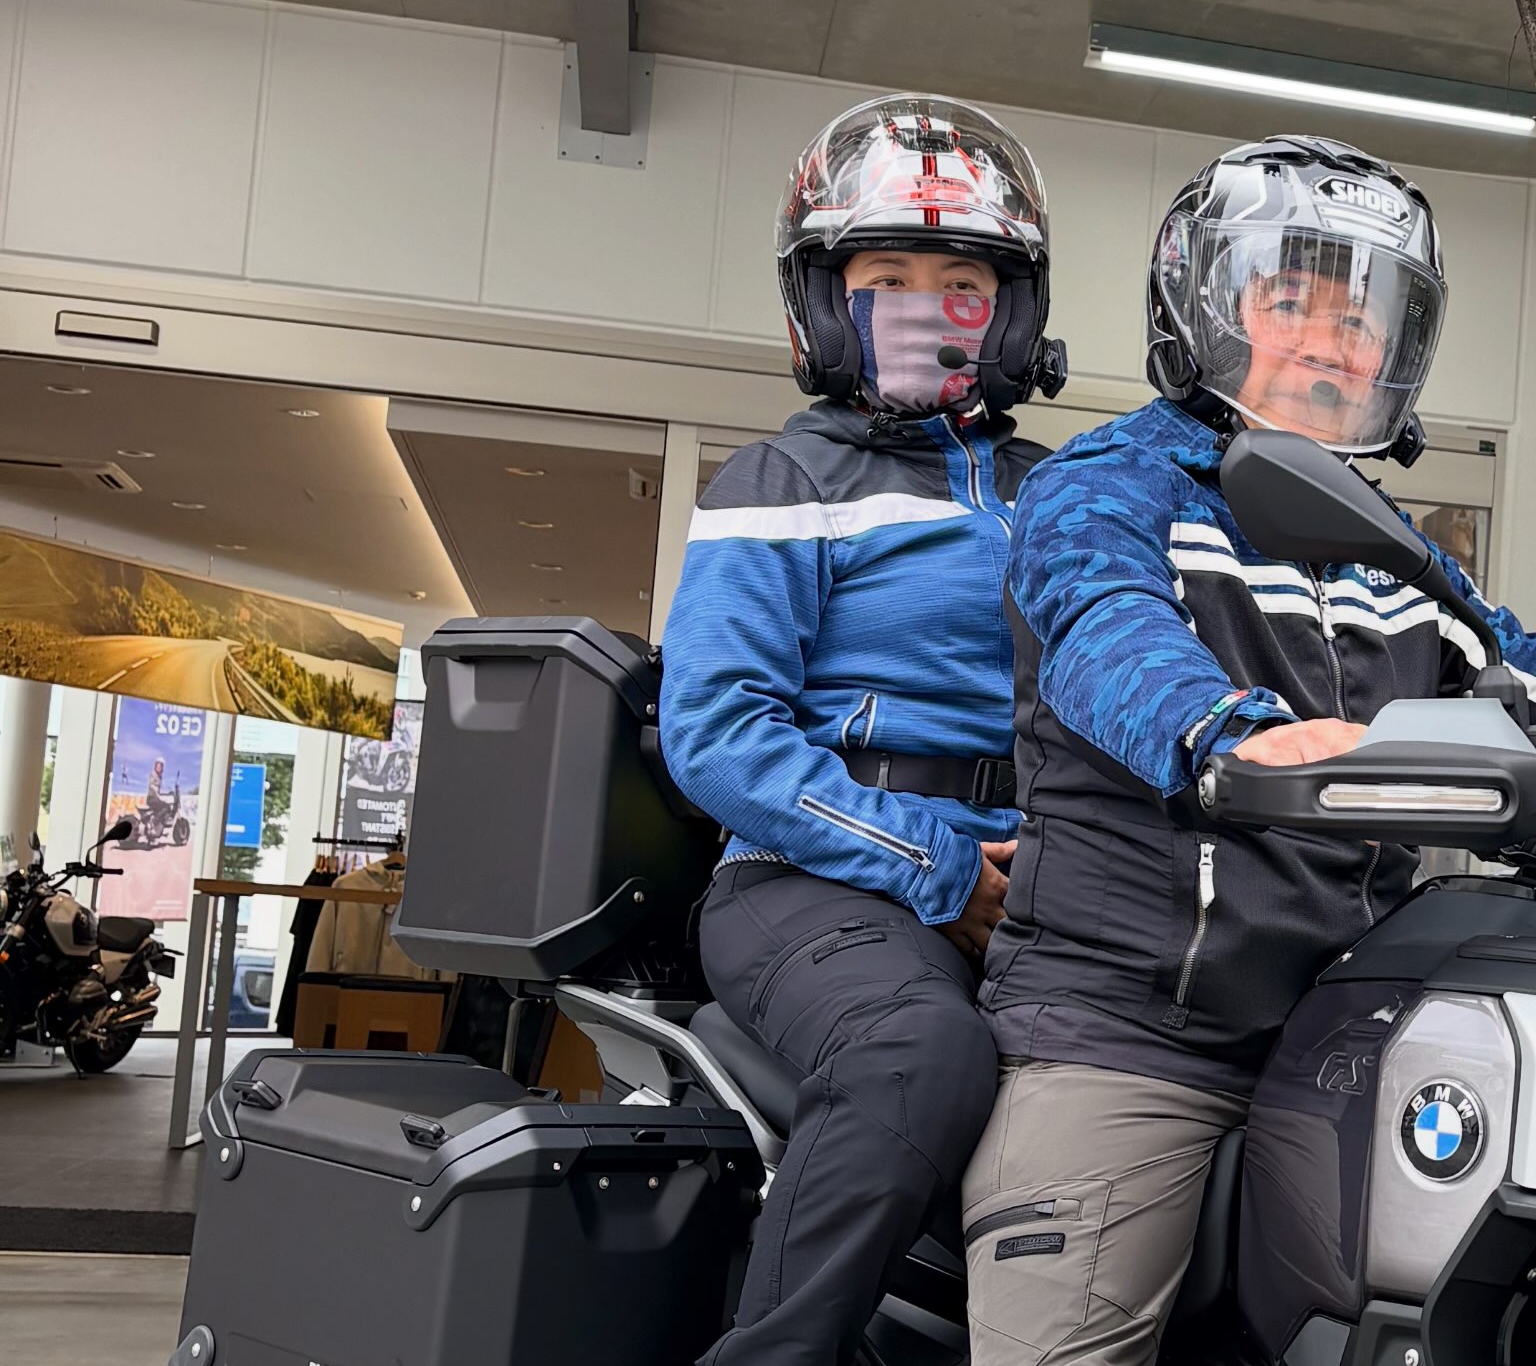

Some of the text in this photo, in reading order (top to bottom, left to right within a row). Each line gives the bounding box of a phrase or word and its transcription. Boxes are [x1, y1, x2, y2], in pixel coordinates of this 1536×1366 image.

[1330, 180, 1401, 222] SHOEI
[1316, 1051, 1376, 1095] GS
[1410, 1085, 1475, 1120] BMW
